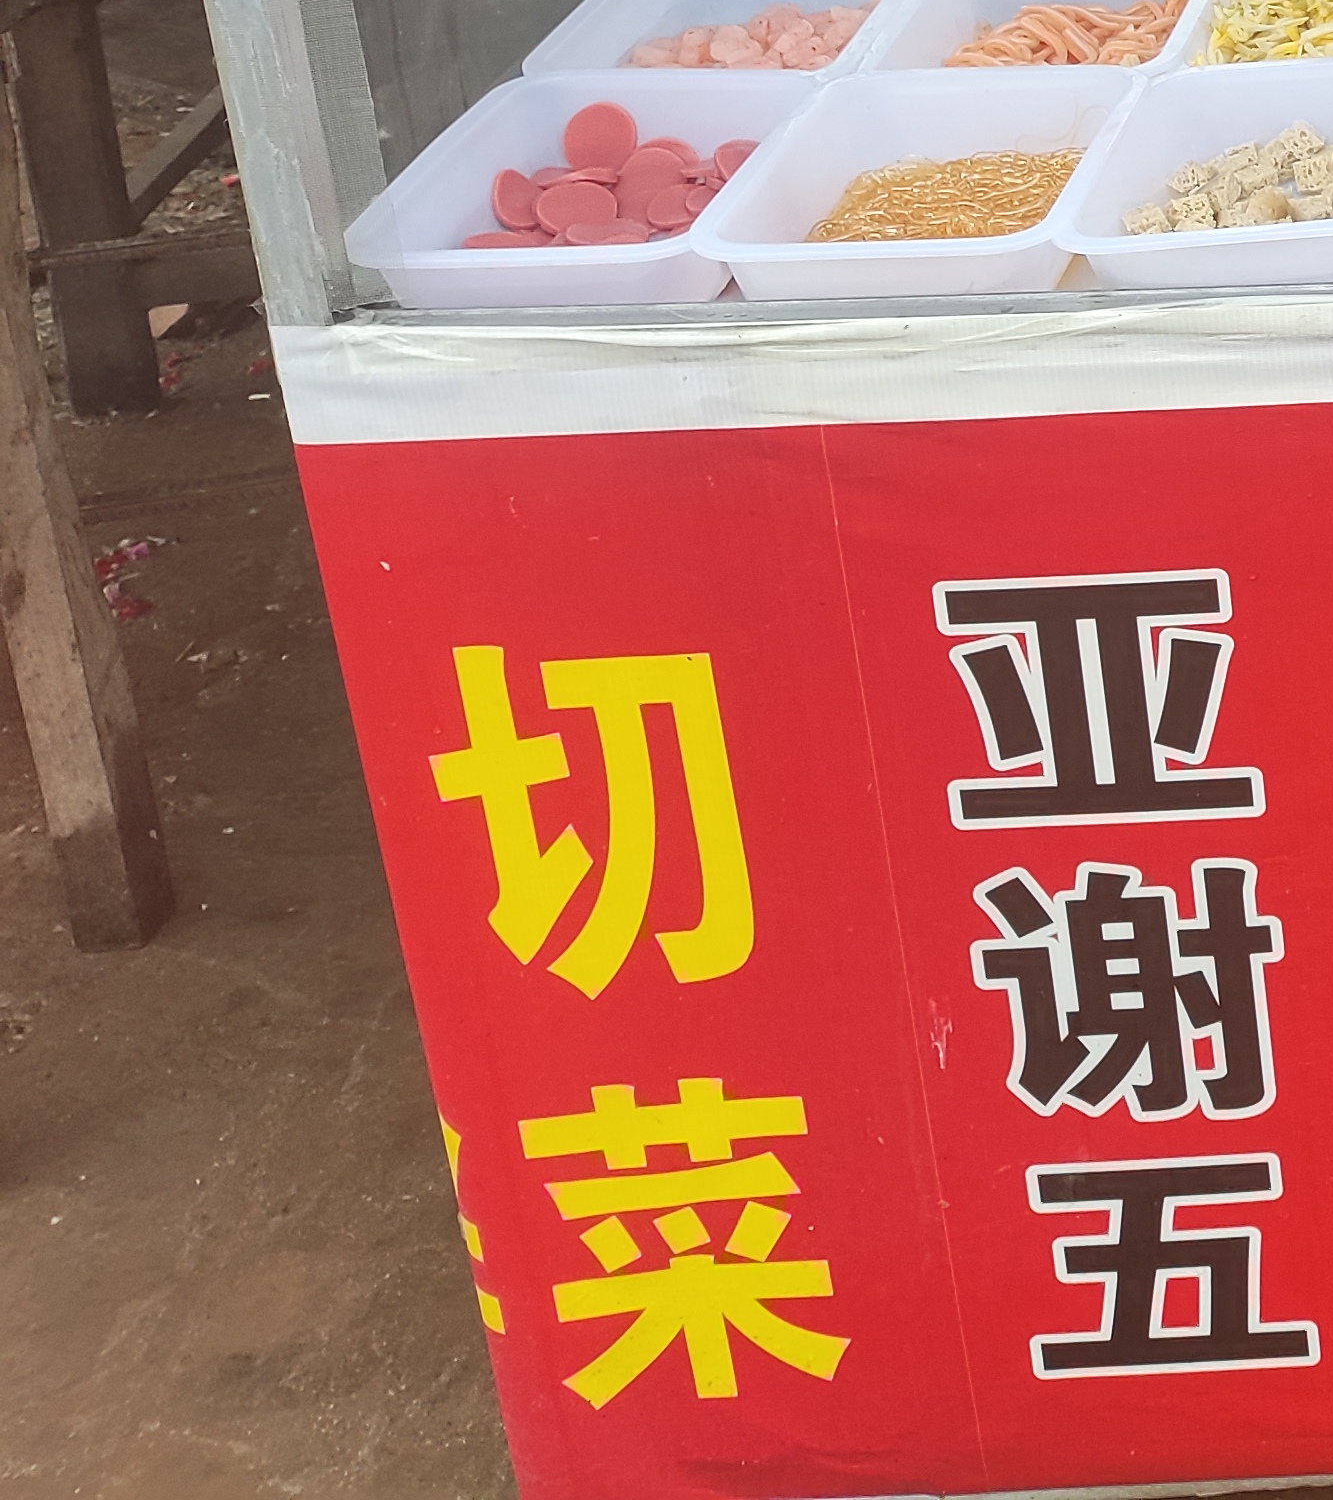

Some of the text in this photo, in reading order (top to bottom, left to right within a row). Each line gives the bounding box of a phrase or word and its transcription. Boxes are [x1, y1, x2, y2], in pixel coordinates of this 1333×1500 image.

[432, 645, 755, 998] 切
[931, 567, 1320, 1380] 亚谢五
[440, 1078, 850, 1409] 菜
